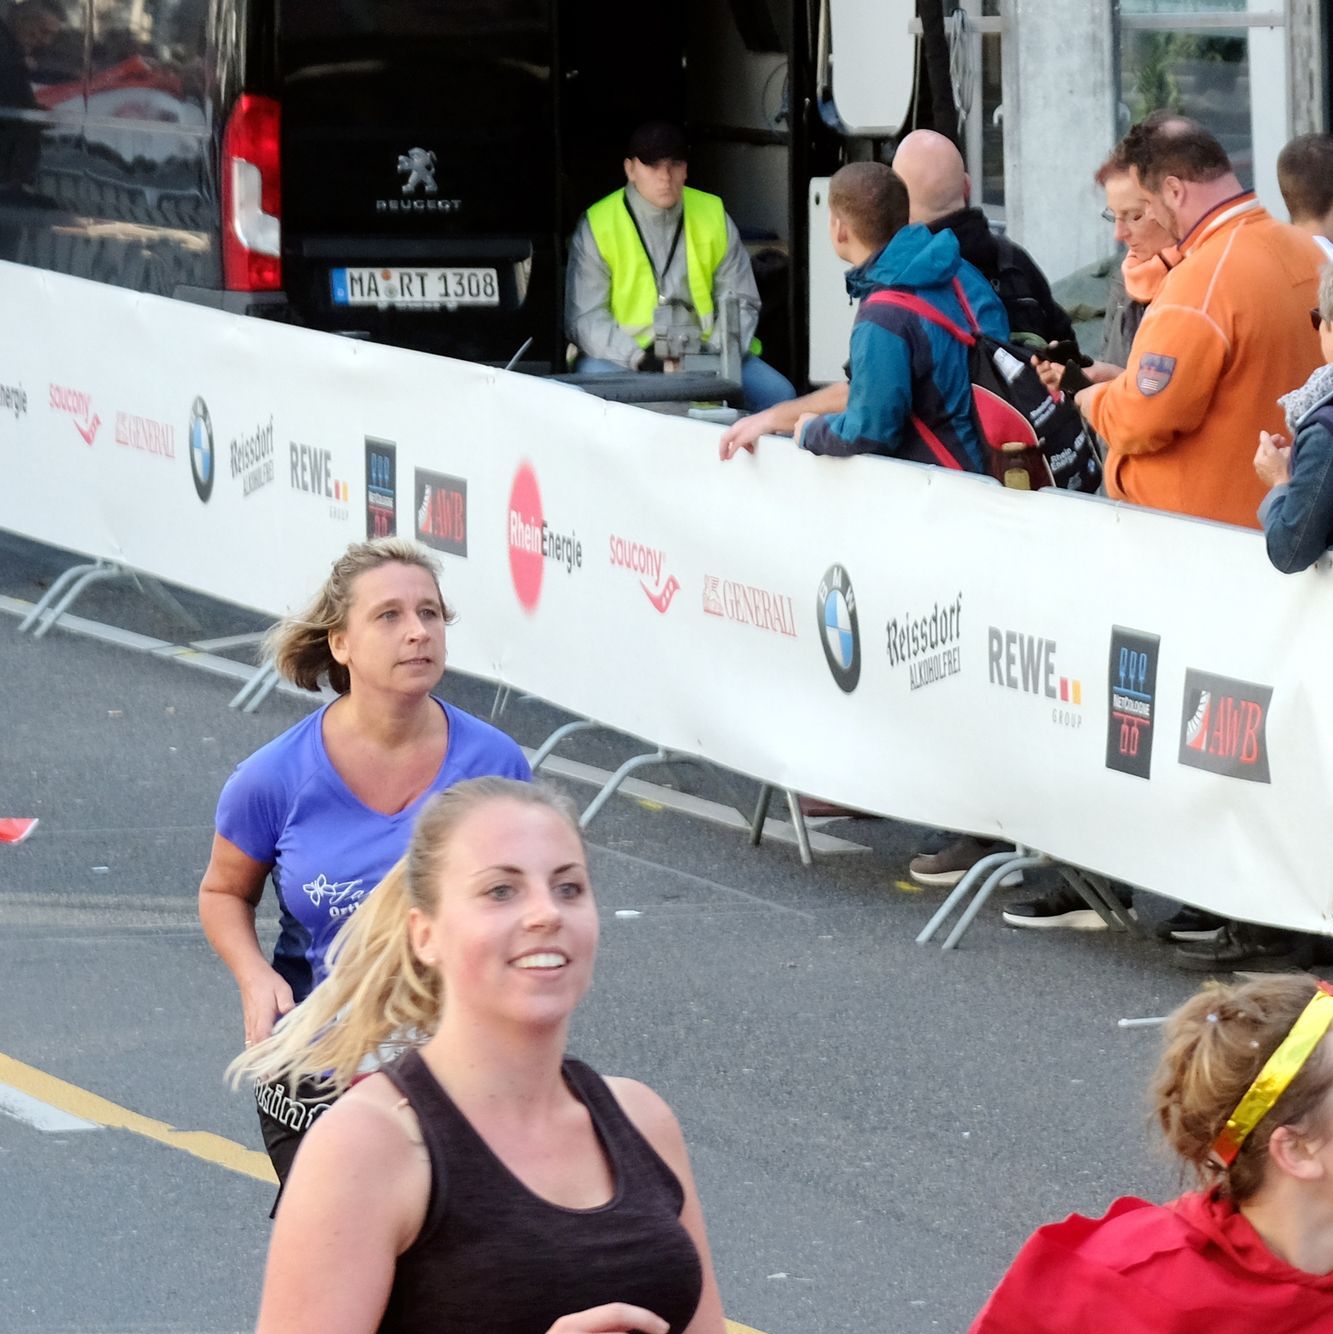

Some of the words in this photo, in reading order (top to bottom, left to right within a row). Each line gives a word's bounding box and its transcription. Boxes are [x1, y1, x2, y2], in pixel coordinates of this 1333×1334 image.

[376, 199, 462, 211] PEUGEOT
[350, 272, 380, 297] MA
[400, 272, 428, 297] RT
[437, 272, 495, 297] 1308
[49, 383, 91, 424] saucony
[129, 415, 176, 459] GENERALI
[230, 414, 274, 479] Reissdorf
[289, 440, 333, 498] REWE
[434, 487, 466, 543] AWB
[509, 509, 583, 574] RheinEnergie
[609, 533, 664, 587] saucony
[723, 580, 798, 637] GENERALI
[886, 590, 963, 667] Reissdorf
[909, 646, 961, 692] ALKOHOLFREI
[988, 626, 1057, 699] REWE
[1051, 708, 1083, 729] GROUP
[1208, 695, 1262, 765] AWB
